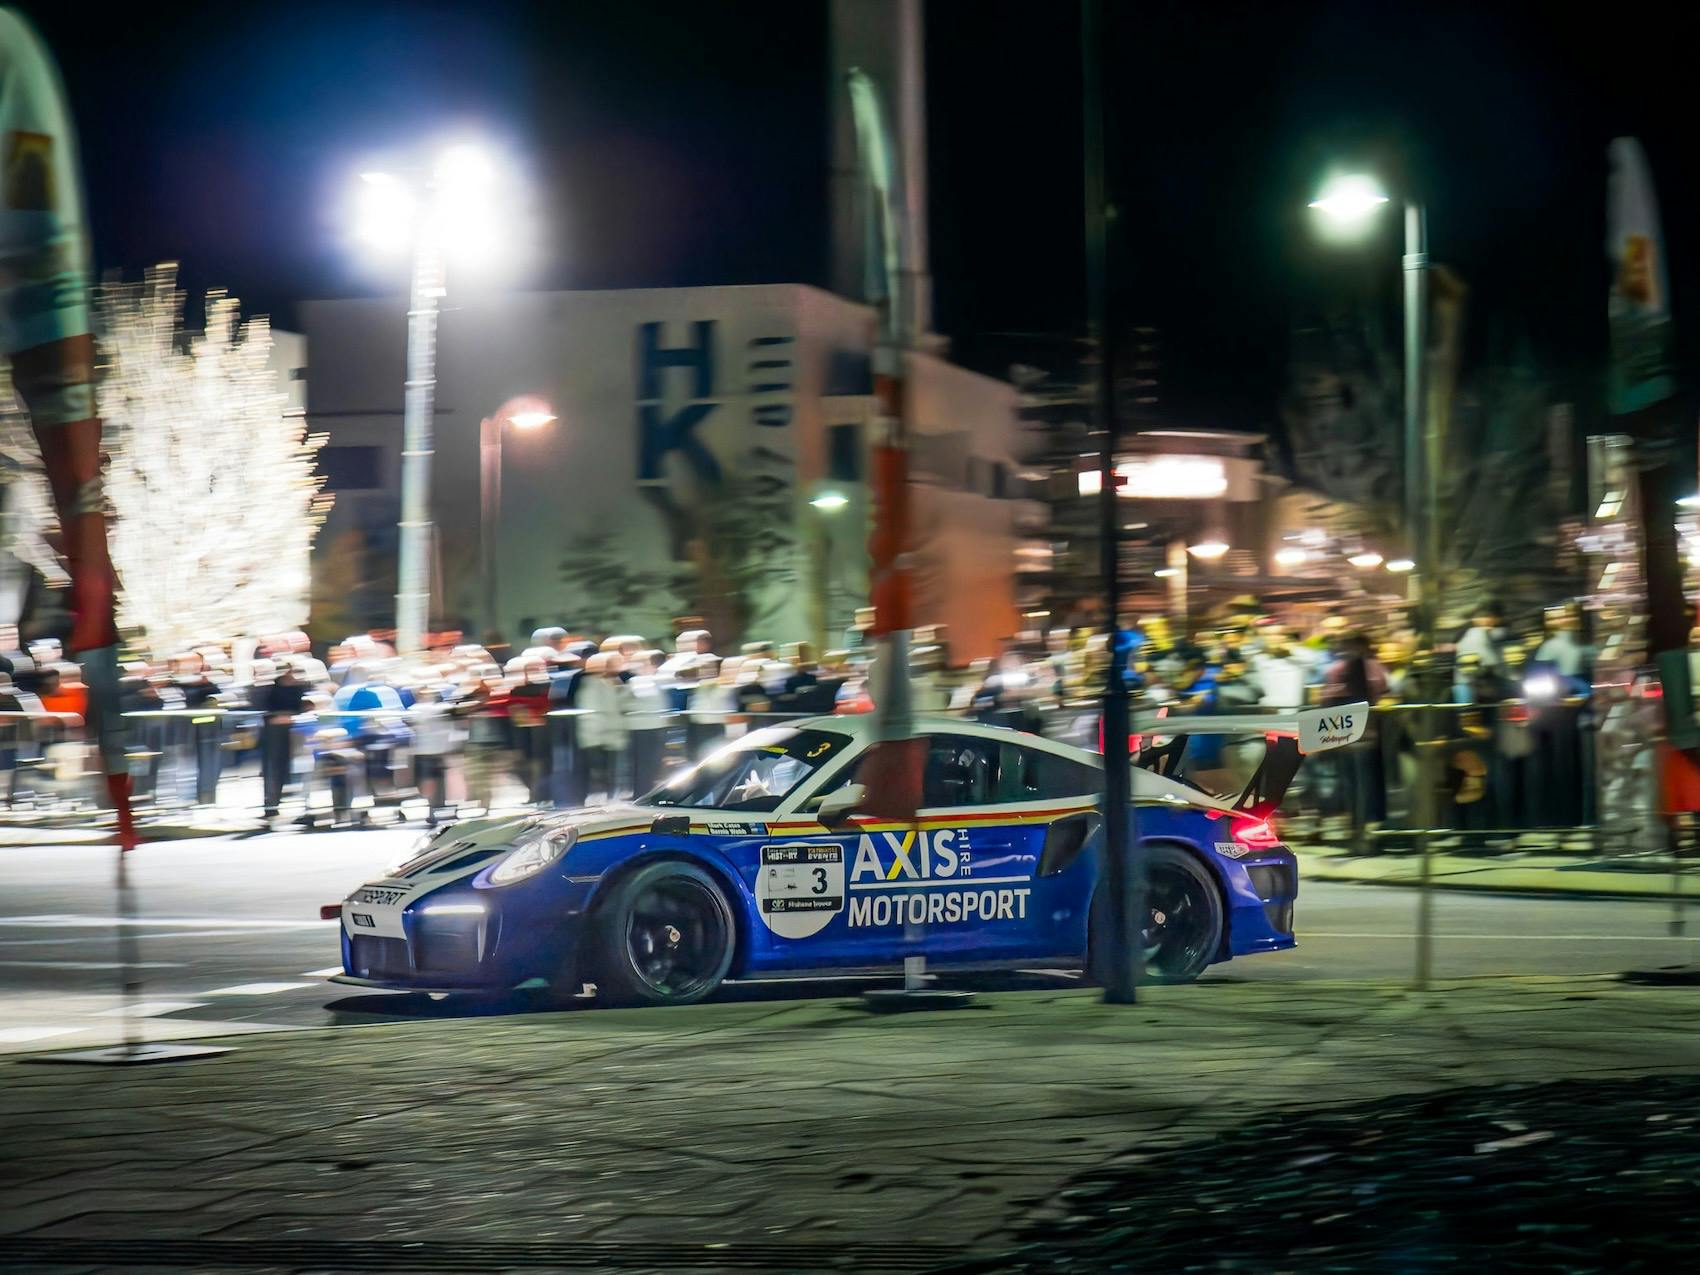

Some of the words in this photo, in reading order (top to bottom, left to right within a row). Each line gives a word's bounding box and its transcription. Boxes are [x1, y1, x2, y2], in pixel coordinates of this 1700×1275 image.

[1317, 713, 1354, 732] AXIS
[807, 742, 832, 758] 3
[850, 829, 959, 881] AXIS
[956, 828, 972, 877] HIRE
[811, 867, 828, 895] 3
[848, 888, 1031, 928] MOTORSPORT
